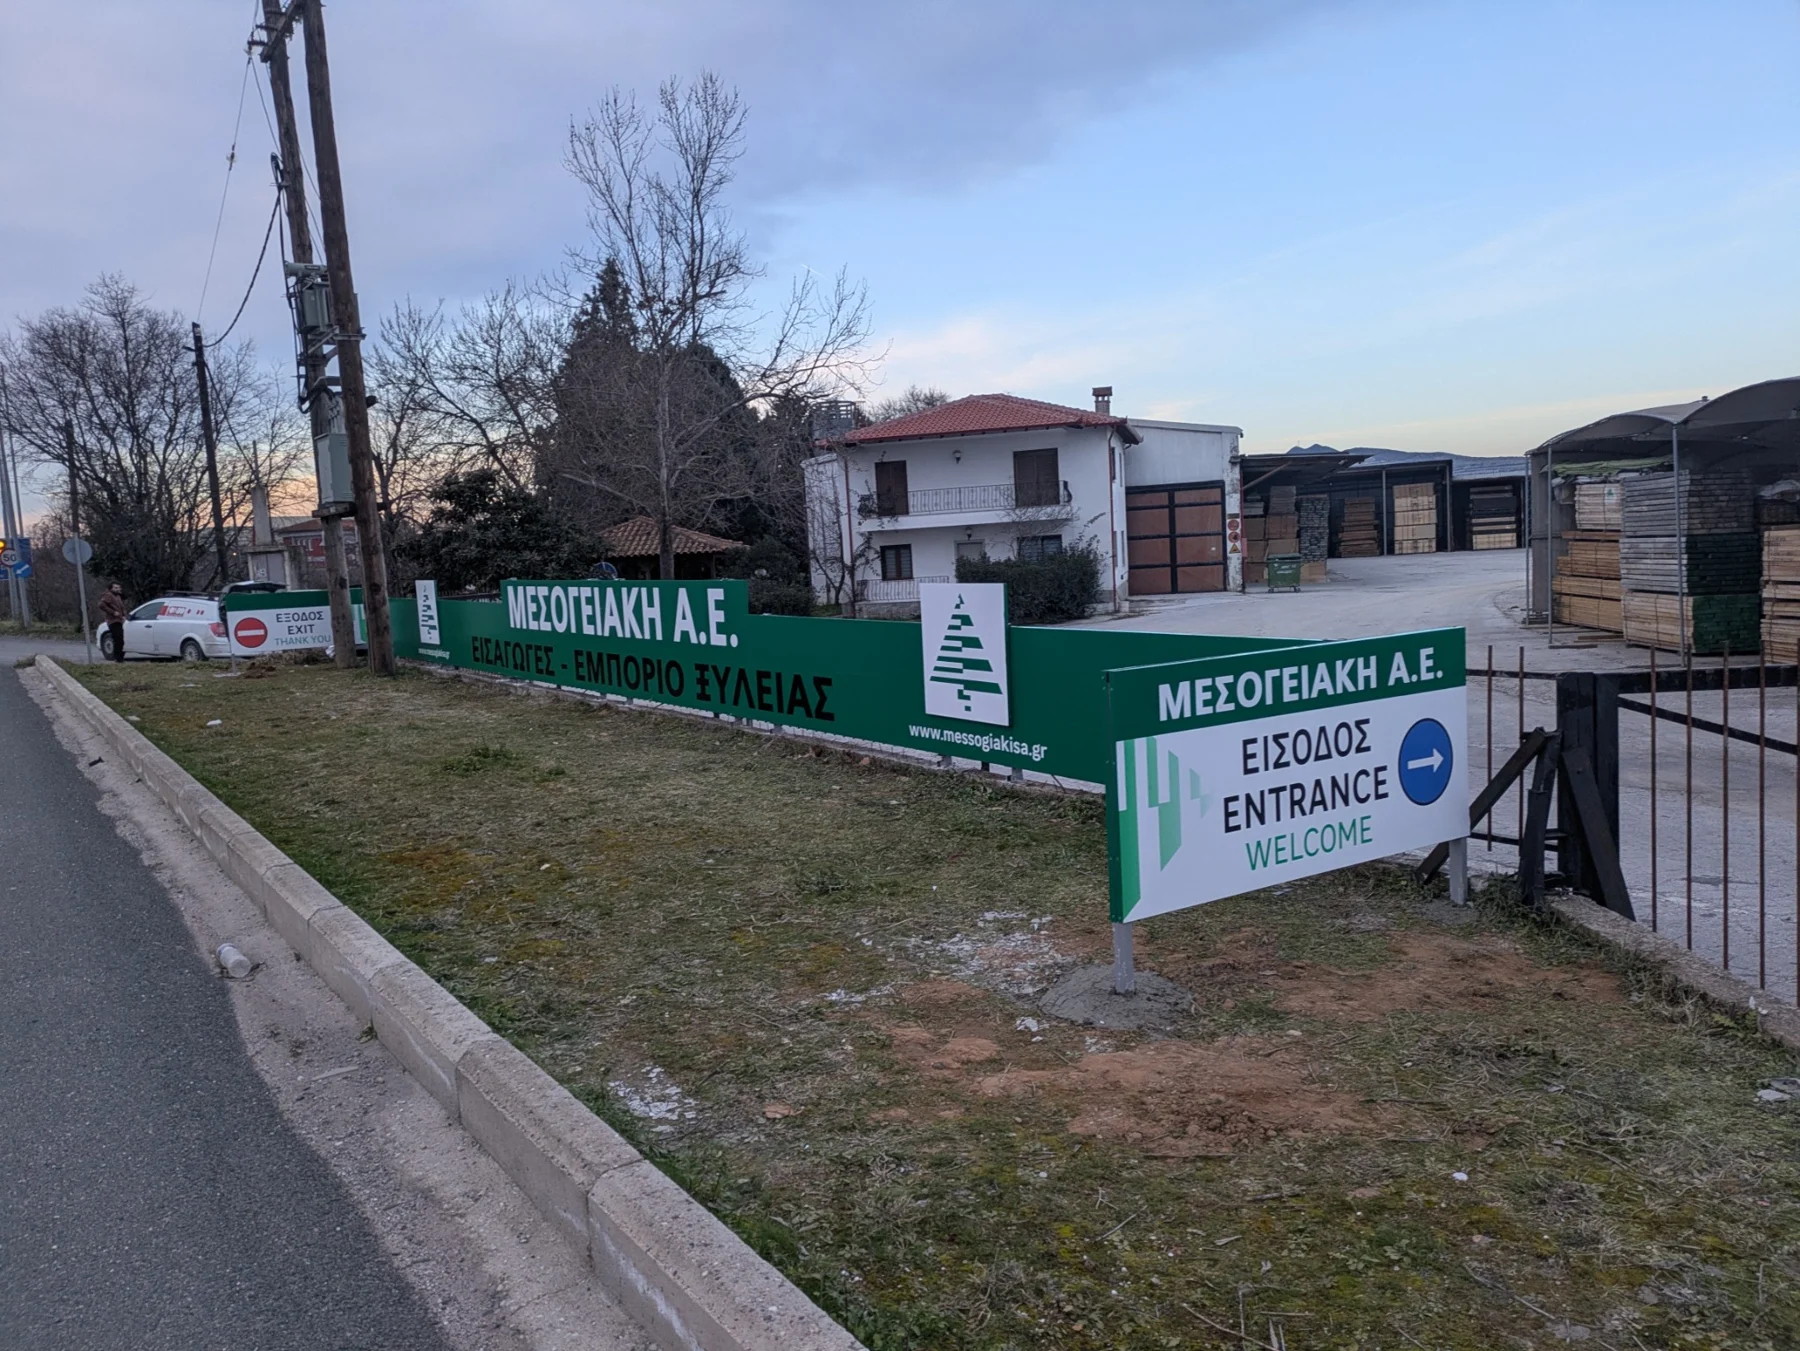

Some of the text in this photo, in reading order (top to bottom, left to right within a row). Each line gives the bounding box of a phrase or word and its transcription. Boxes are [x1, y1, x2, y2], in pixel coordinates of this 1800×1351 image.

[3, 553, 17, 562] 50
[274, 634, 332, 646] THANK YOU
[276, 611, 324, 623] ΕΞΟΔΟΣ
[287, 624, 315, 635] EXIT
[507, 585, 738, 648] ΜΕΣΟΓΕΙΑΚΗ Α.Ε.
[471, 636, 555, 677] ΕΙΣΑΓΩΓΕΣ
[574, 650, 685, 698] ΕΜΠΟΡΙΟ
[694, 663, 835, 722] ΞΥΛΕΙΑΣ
[1158, 647, 1444, 722] ΜΕΣΟΓΕΙΑΚΗ Α.Ε.
[908, 724, 1048, 761] www.messogiakisa.gr
[1242, 718, 1372, 776] ΕΙΣΟΔΟΣ
[1223, 764, 1389, 834] ENTRANCE
[1245, 815, 1373, 872] WELCOME
